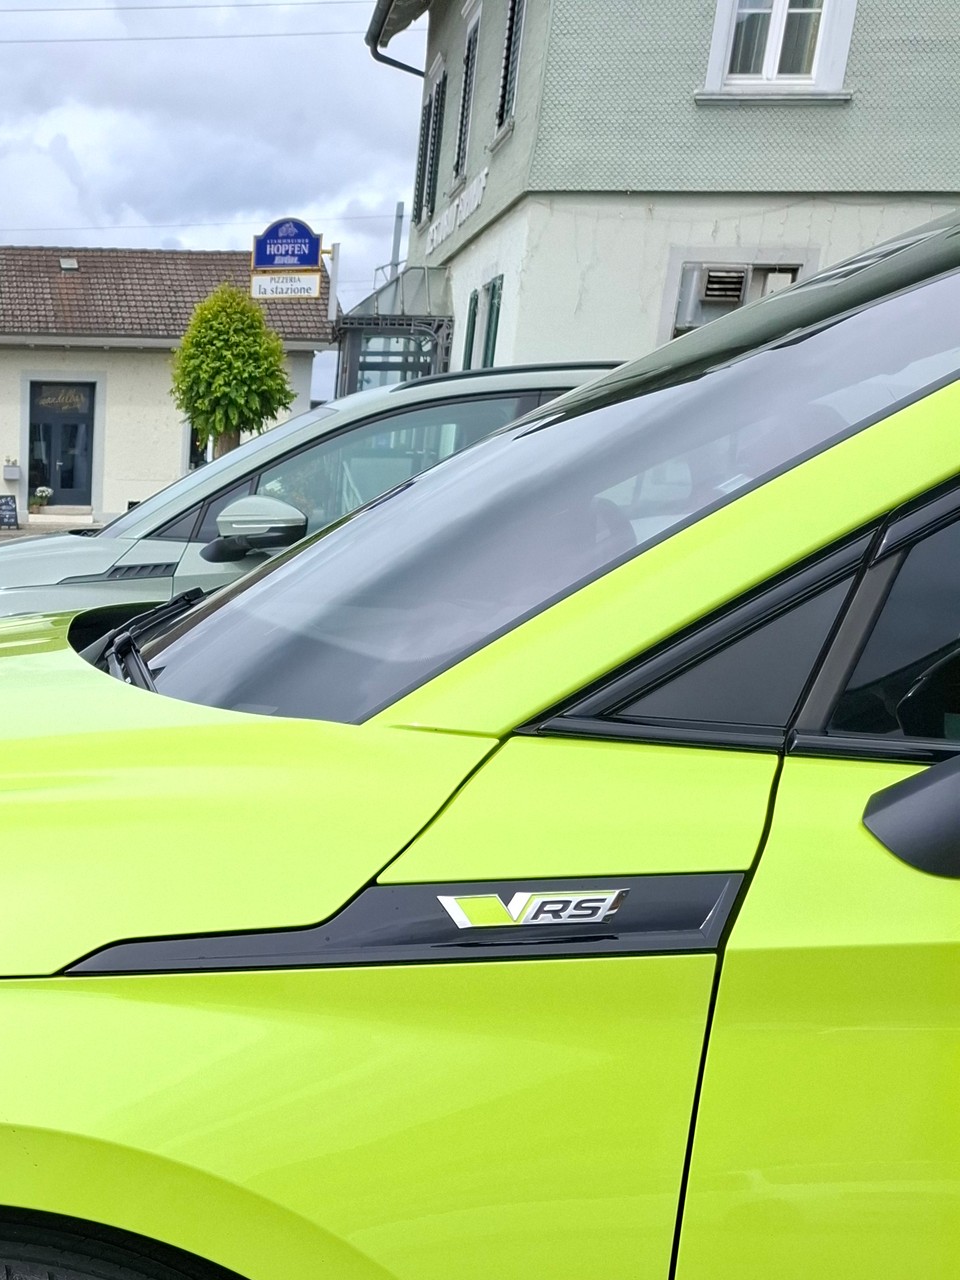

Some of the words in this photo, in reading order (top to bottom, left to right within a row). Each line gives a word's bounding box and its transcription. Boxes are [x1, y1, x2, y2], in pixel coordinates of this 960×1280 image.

[266, 243, 309, 255] HOPFEN
[269, 276, 301, 284] PIZZERIA
[258, 284, 267, 295] la
[270, 284, 312, 295] stazione
